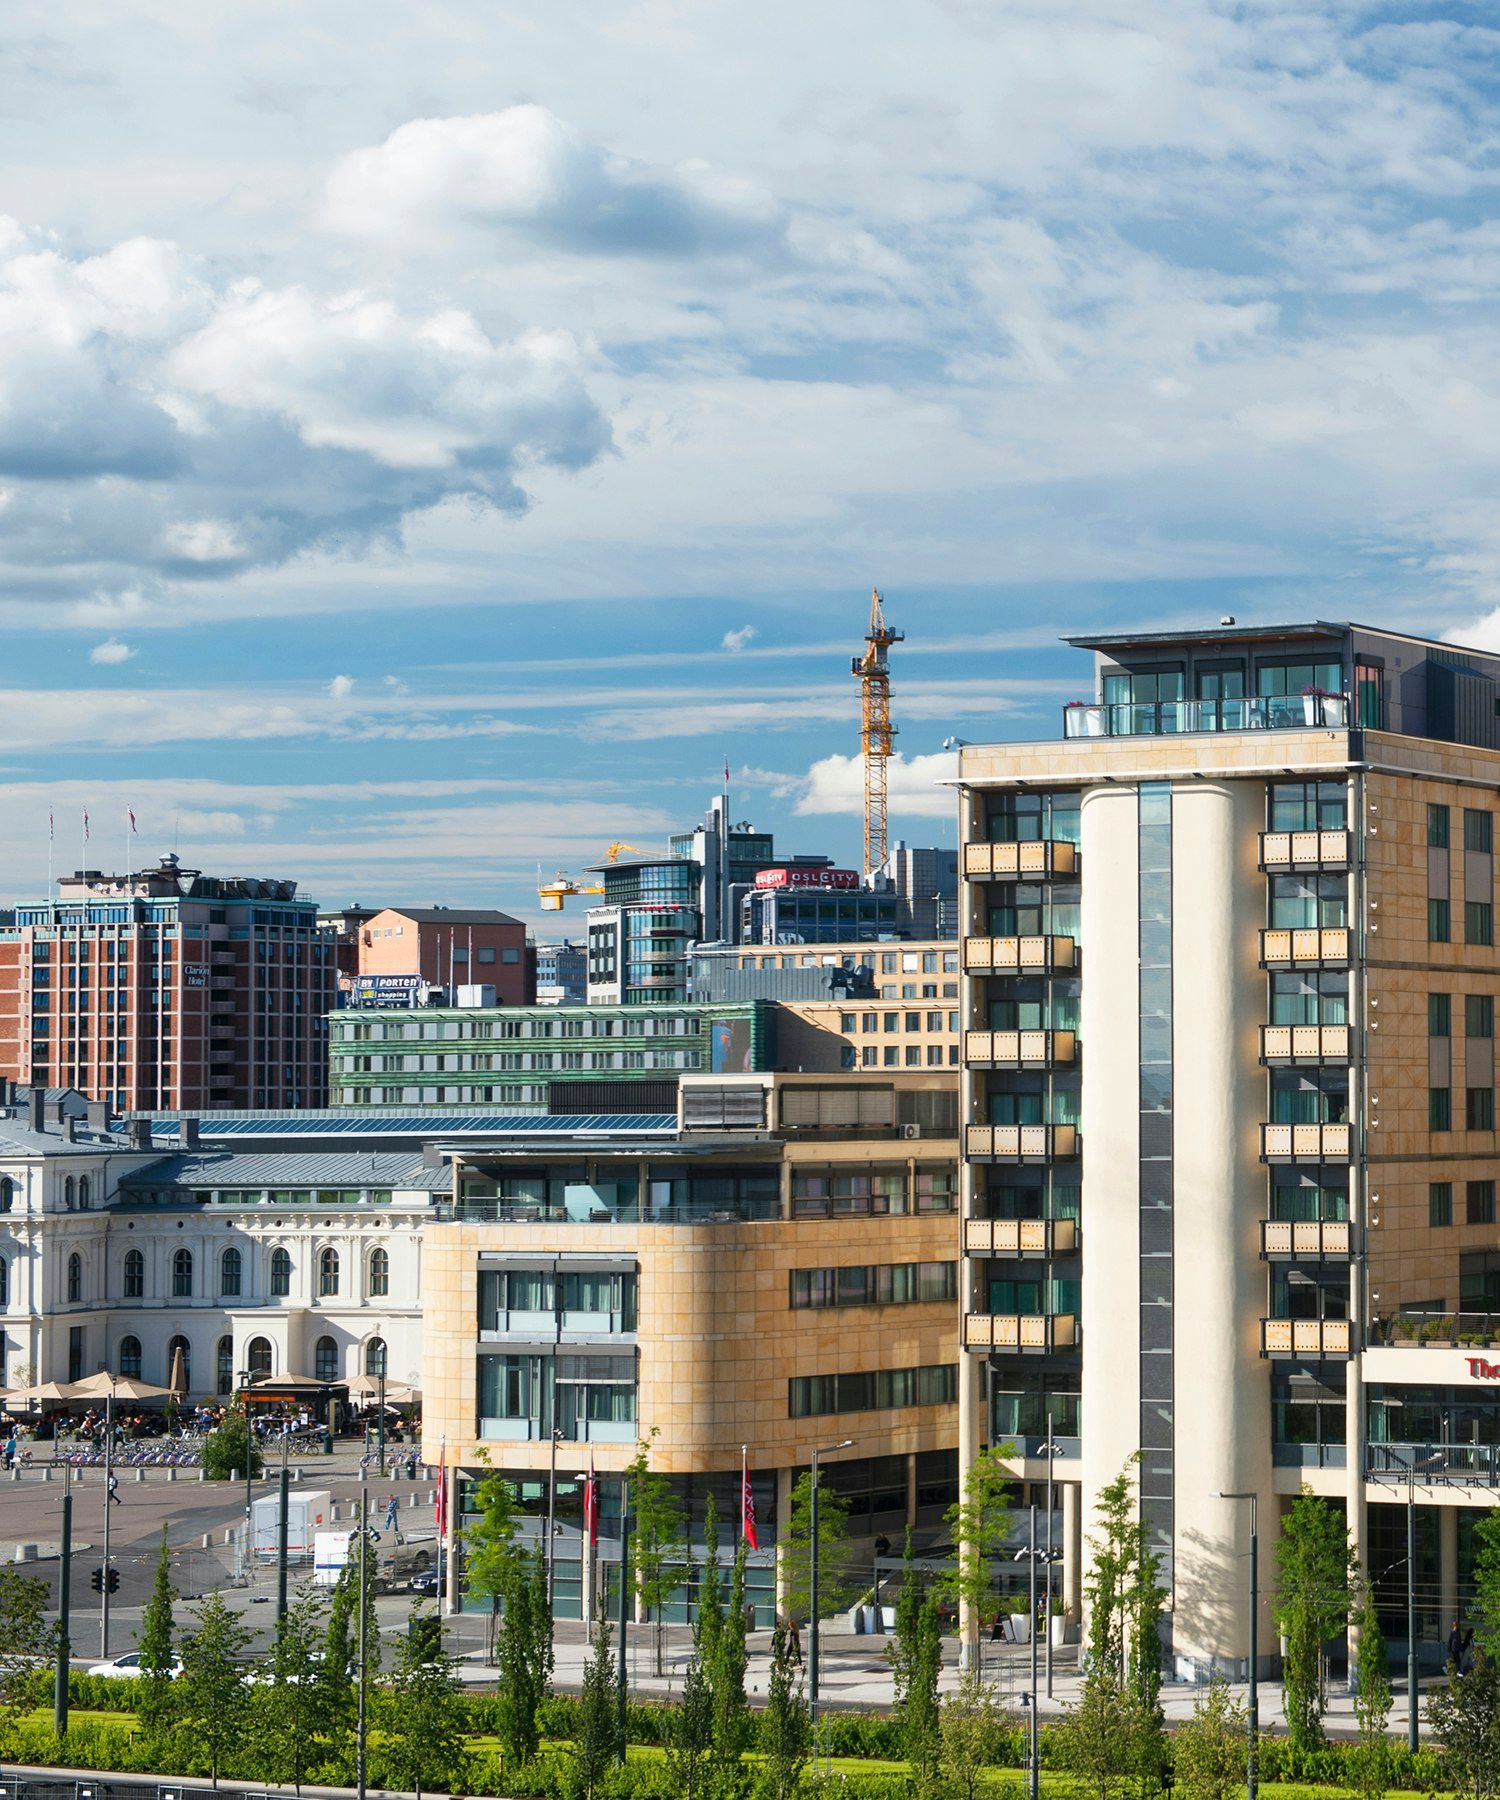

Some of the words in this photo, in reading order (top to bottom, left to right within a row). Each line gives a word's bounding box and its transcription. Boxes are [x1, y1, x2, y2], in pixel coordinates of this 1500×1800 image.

[184, 965, 210, 975] Clarion
[188, 976, 205, 986] Hotel
[361, 979, 373, 988] BY
[377, 991, 407, 999] shopping
